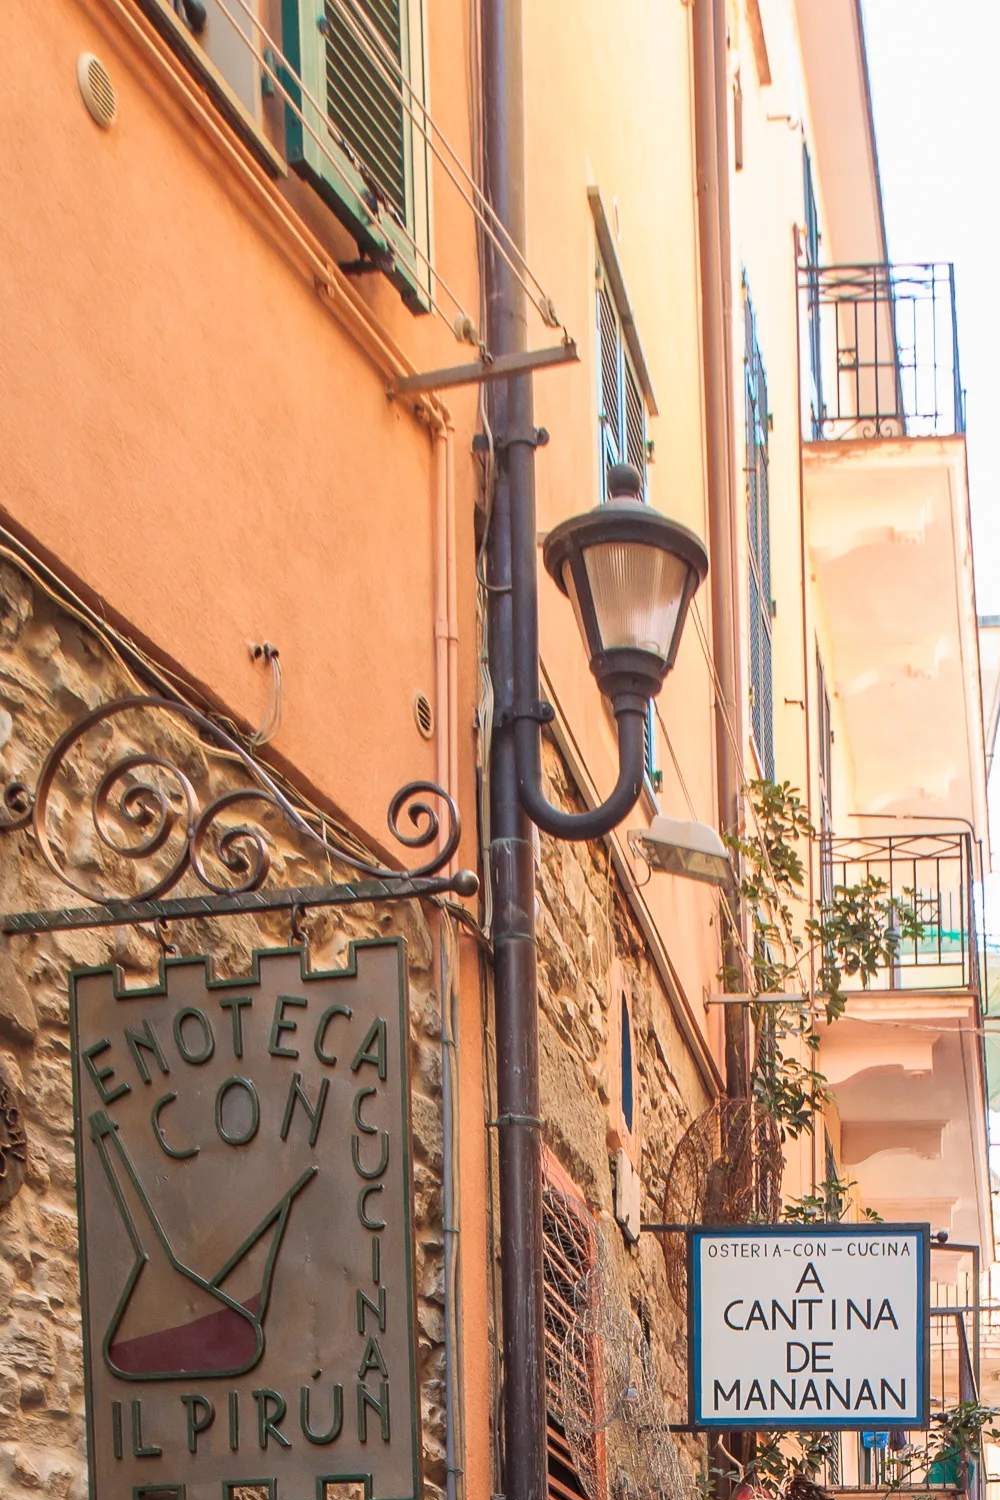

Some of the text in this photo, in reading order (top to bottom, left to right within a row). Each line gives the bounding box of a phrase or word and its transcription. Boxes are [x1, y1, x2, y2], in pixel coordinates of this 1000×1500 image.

[81, 995, 387, 1103] ENOTECA
[150, 1072, 331, 1160] CON
[350, 1086, 390, 1379] CUCINA
[795, 1261, 825, 1294] A
[723, 1298, 899, 1331] CANTINA
[786, 1341, 834, 1374] DE
[712, 1378, 907, 1411] MANANAN
[111, 1398, 163, 1460] IL
